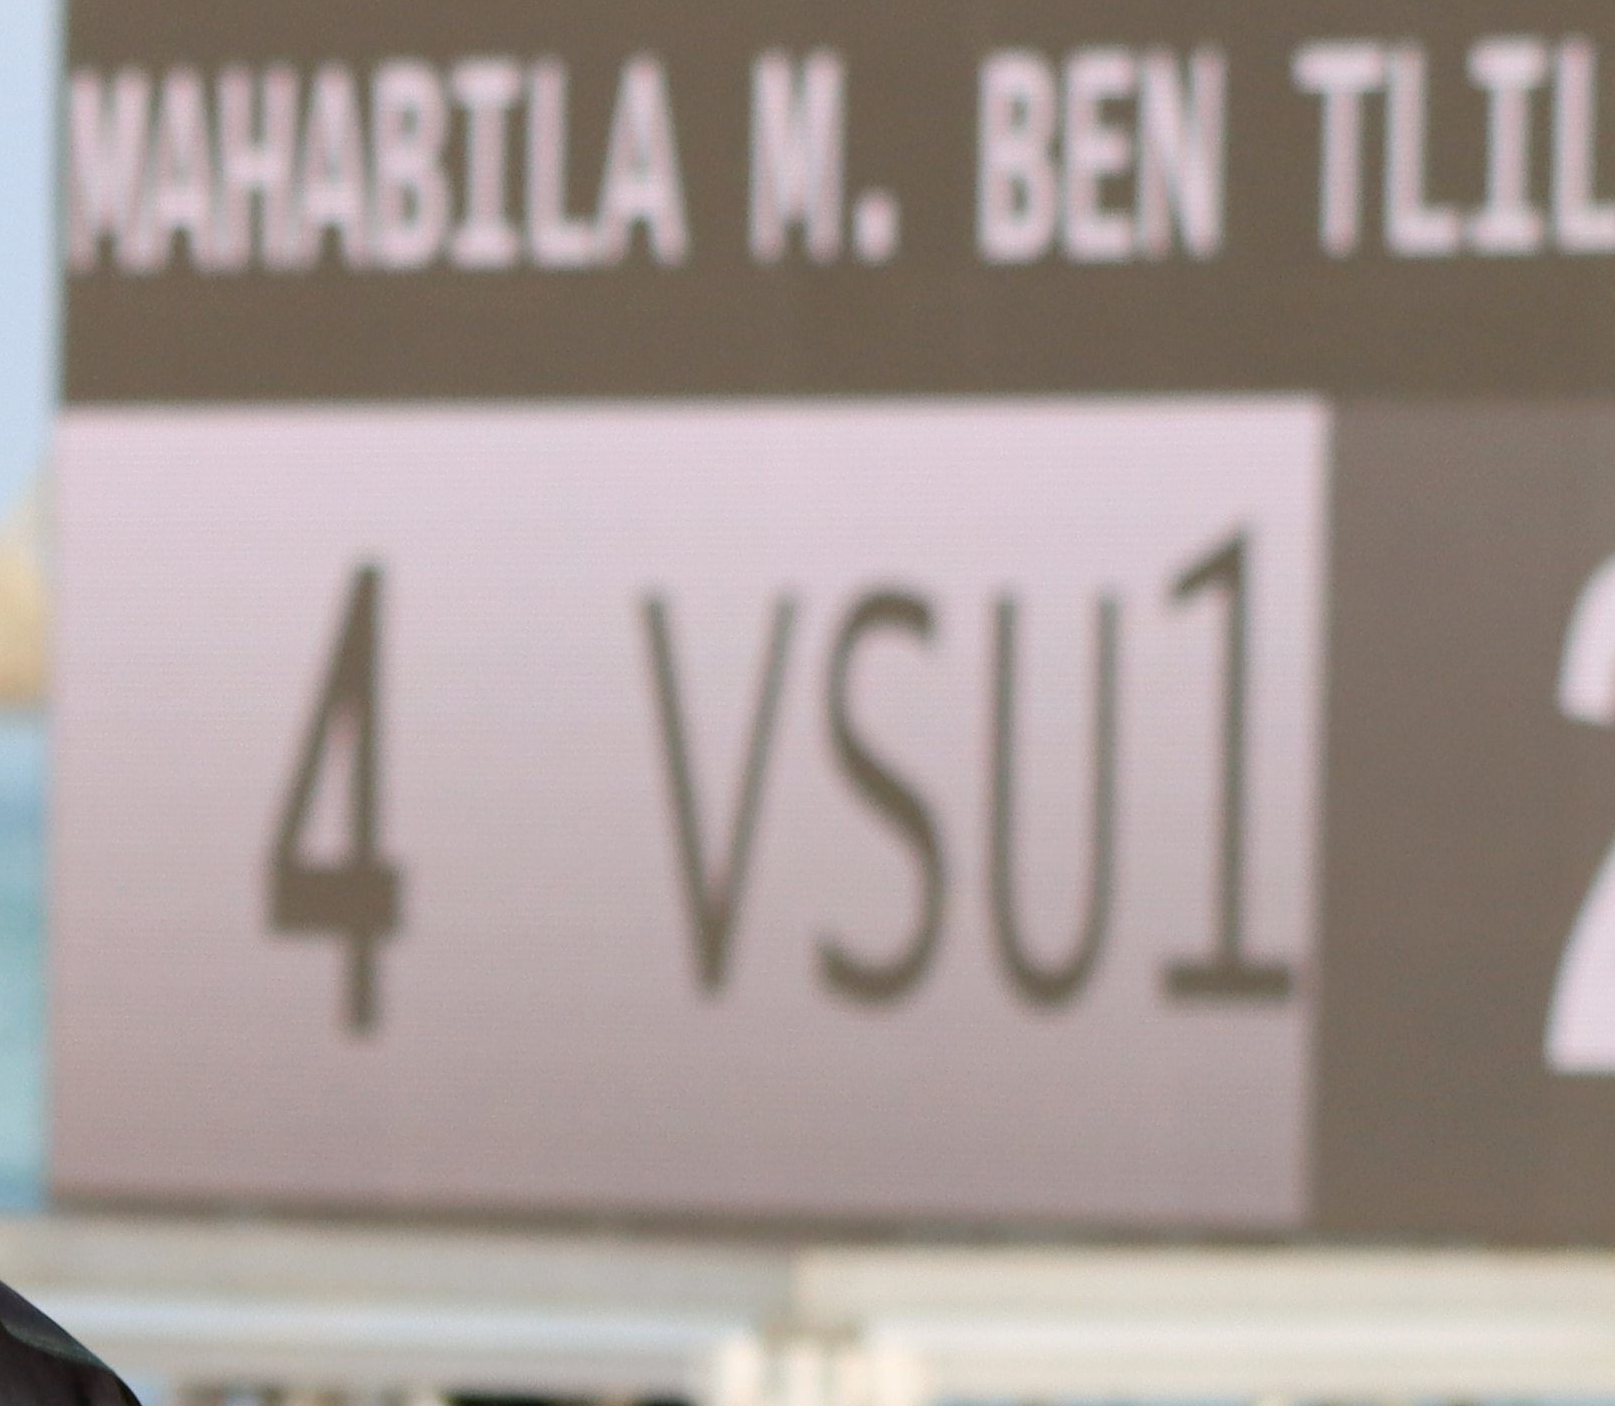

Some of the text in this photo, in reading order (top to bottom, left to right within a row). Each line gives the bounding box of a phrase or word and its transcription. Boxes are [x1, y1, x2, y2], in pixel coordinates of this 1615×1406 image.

[68, 36, 1615, 272] MAHABILA M. BEN TLIL
[259, 558, 410, 1043] 4
[637, 519, 1298, 1010] VSU1
